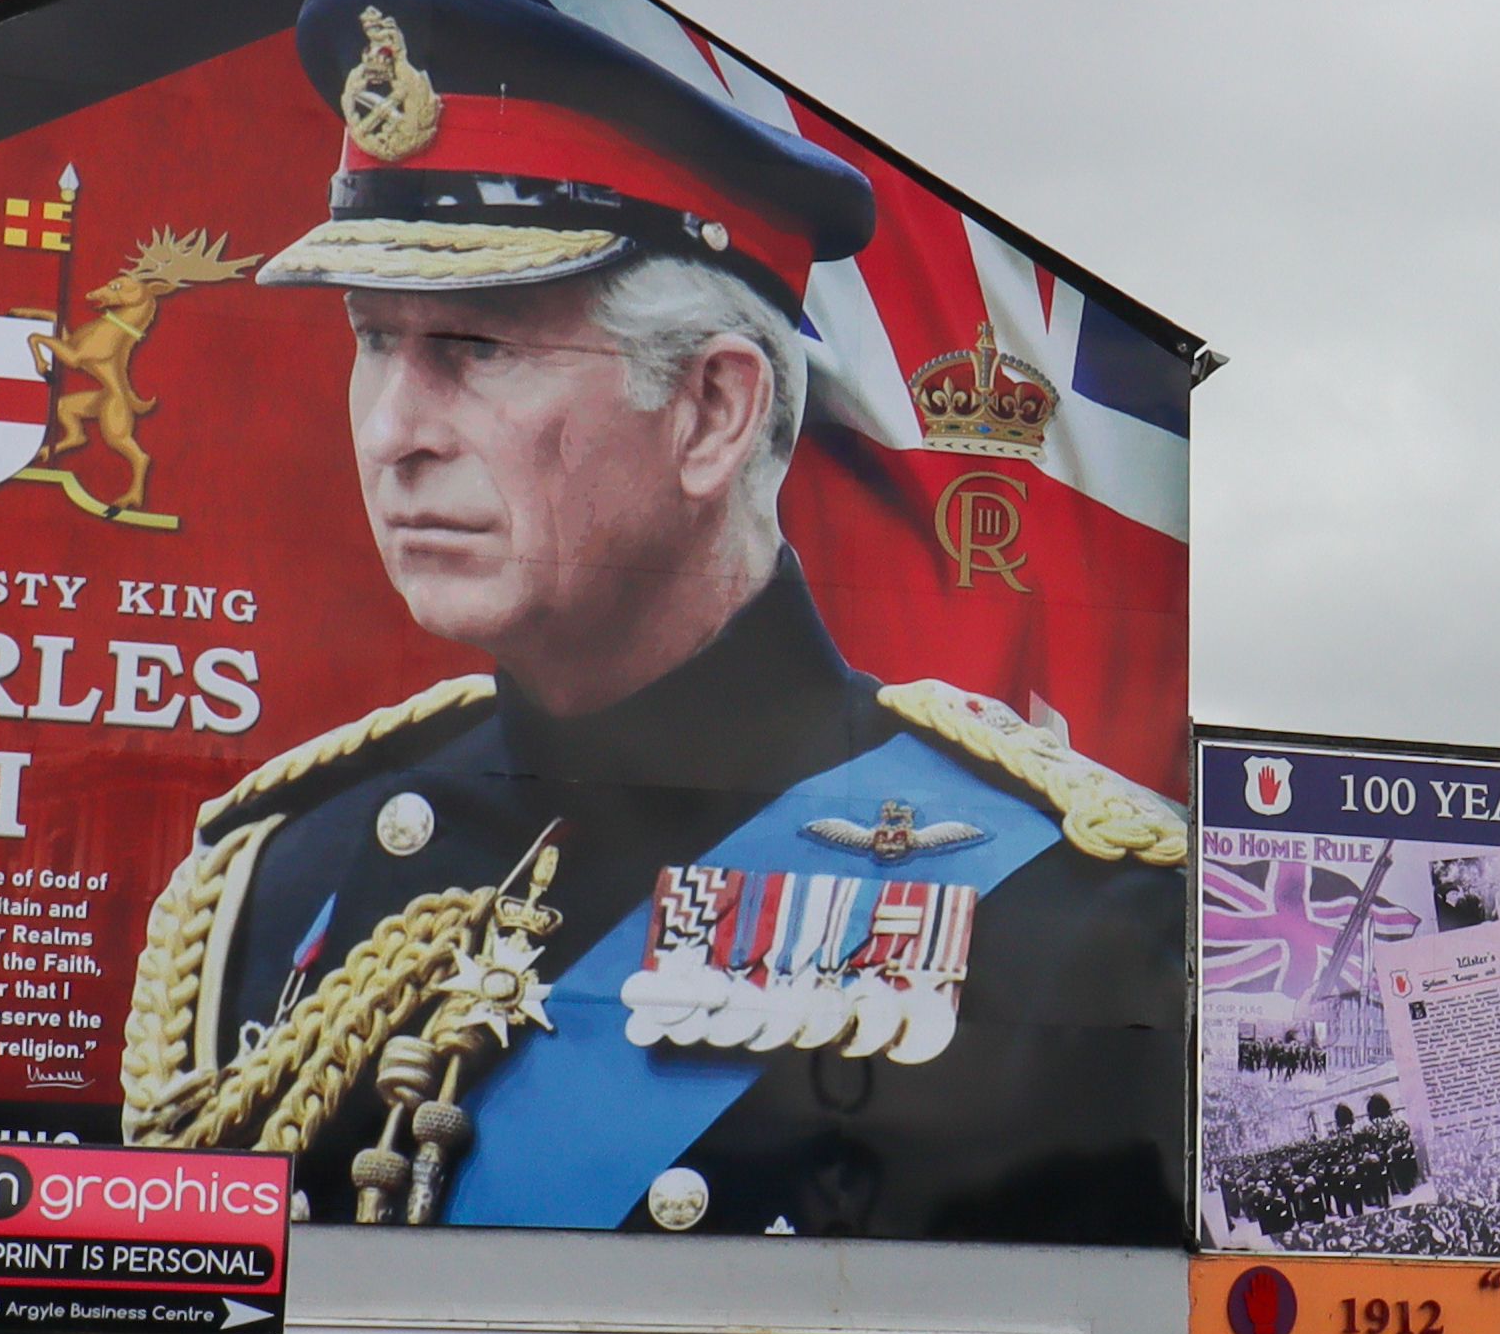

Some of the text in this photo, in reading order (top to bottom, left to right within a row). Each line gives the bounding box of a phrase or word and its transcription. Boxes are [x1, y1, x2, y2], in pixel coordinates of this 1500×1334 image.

[118, 580, 258, 623] KING
[1339, 774, 1417, 817] 100
[12, 868, 34, 887] of
[39, 869, 80, 889] God
[87, 872, 109, 891] of
[48, 900, 88, 919] and
[13, 925, 93, 946] Realms
[3, 952, 37, 971] the
[44, 954, 102, 977] Faith,
[15, 980, 56, 999] that
[63, 982, 71, 1000] I
[68, 1009, 102, 1028] the
[39, 1166, 281, 1223] graphics
[82, 1245, 104, 1271] IS
[113, 1245, 266, 1277] PERSONAL
[5, 1301, 66, 1322] Argyle
[70, 1303, 147, 1321] Business
[152, 1305, 215, 1324] Centre
